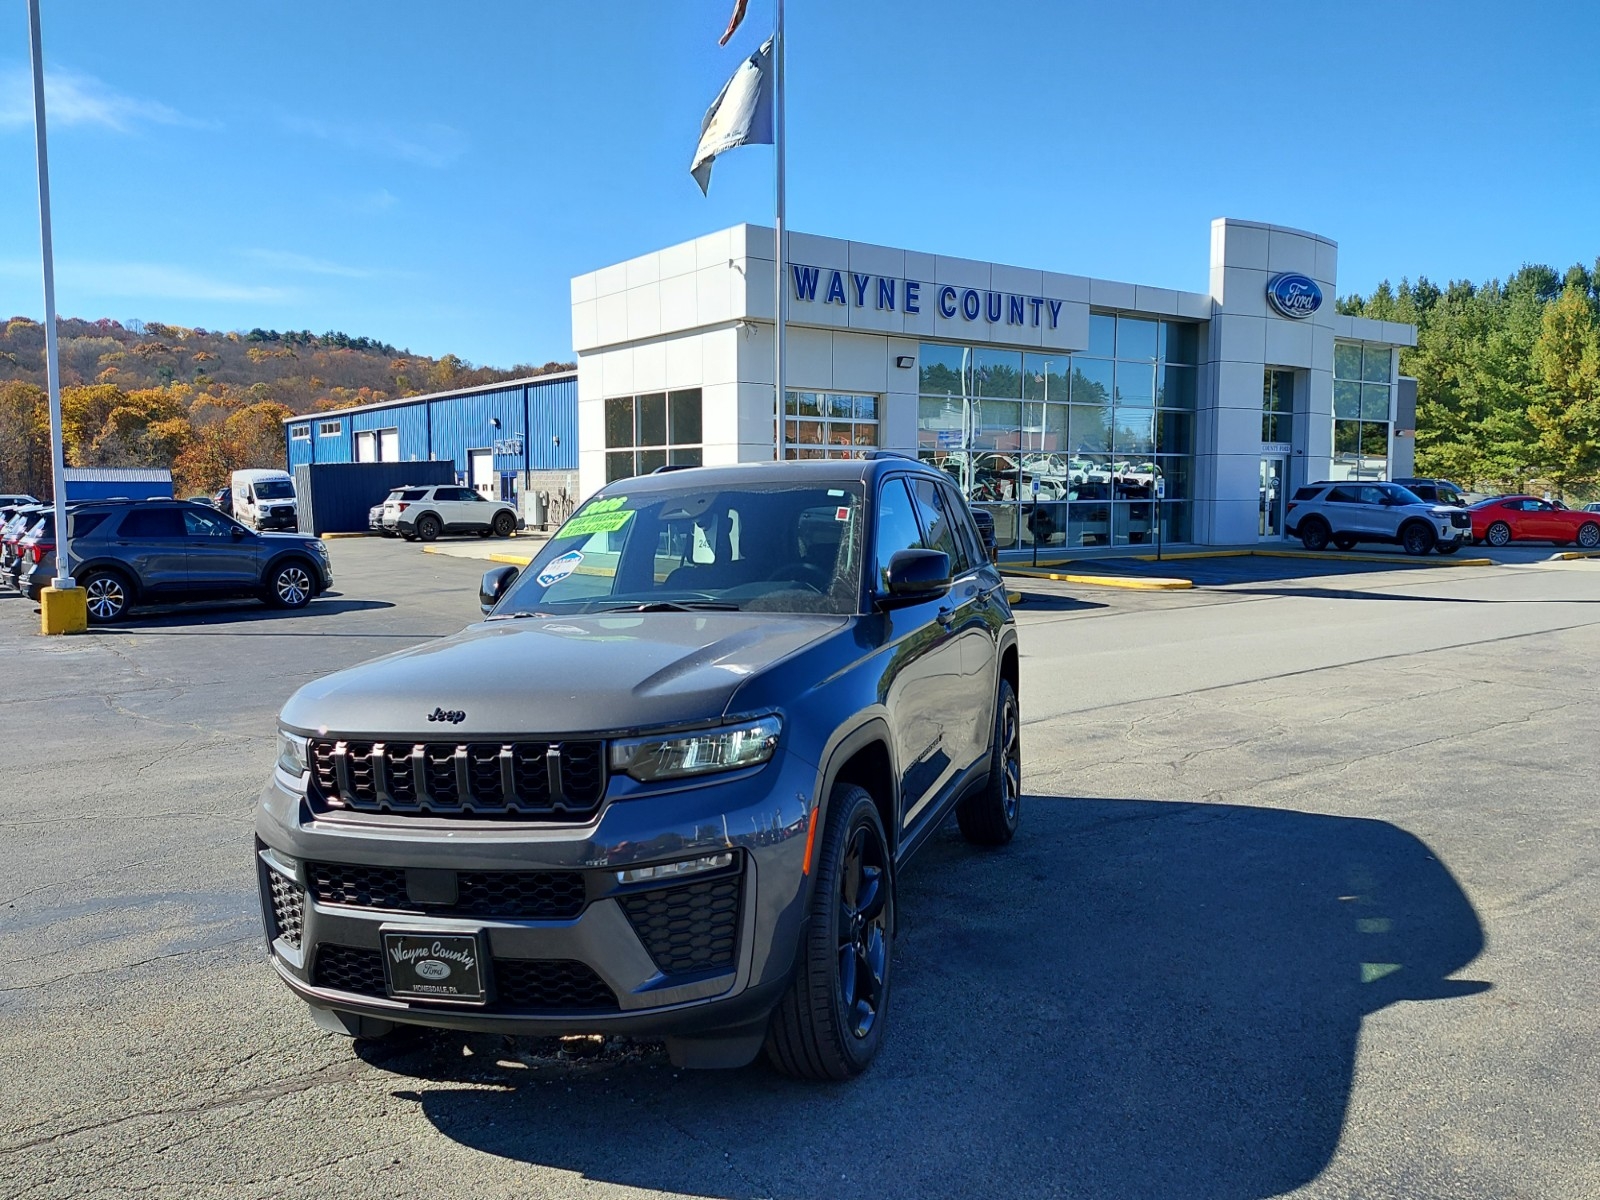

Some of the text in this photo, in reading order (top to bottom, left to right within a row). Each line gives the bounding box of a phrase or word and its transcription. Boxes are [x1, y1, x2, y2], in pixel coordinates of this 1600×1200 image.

[792, 265, 1062, 328] WAYNE COUNTY
[1285, 282, 1314, 308] Ford
[427, 707, 466, 724] Jeep
[390, 941, 475, 971] Wayne County
[422, 963, 443, 975] Ford
[449, 986, 458, 994] PA
